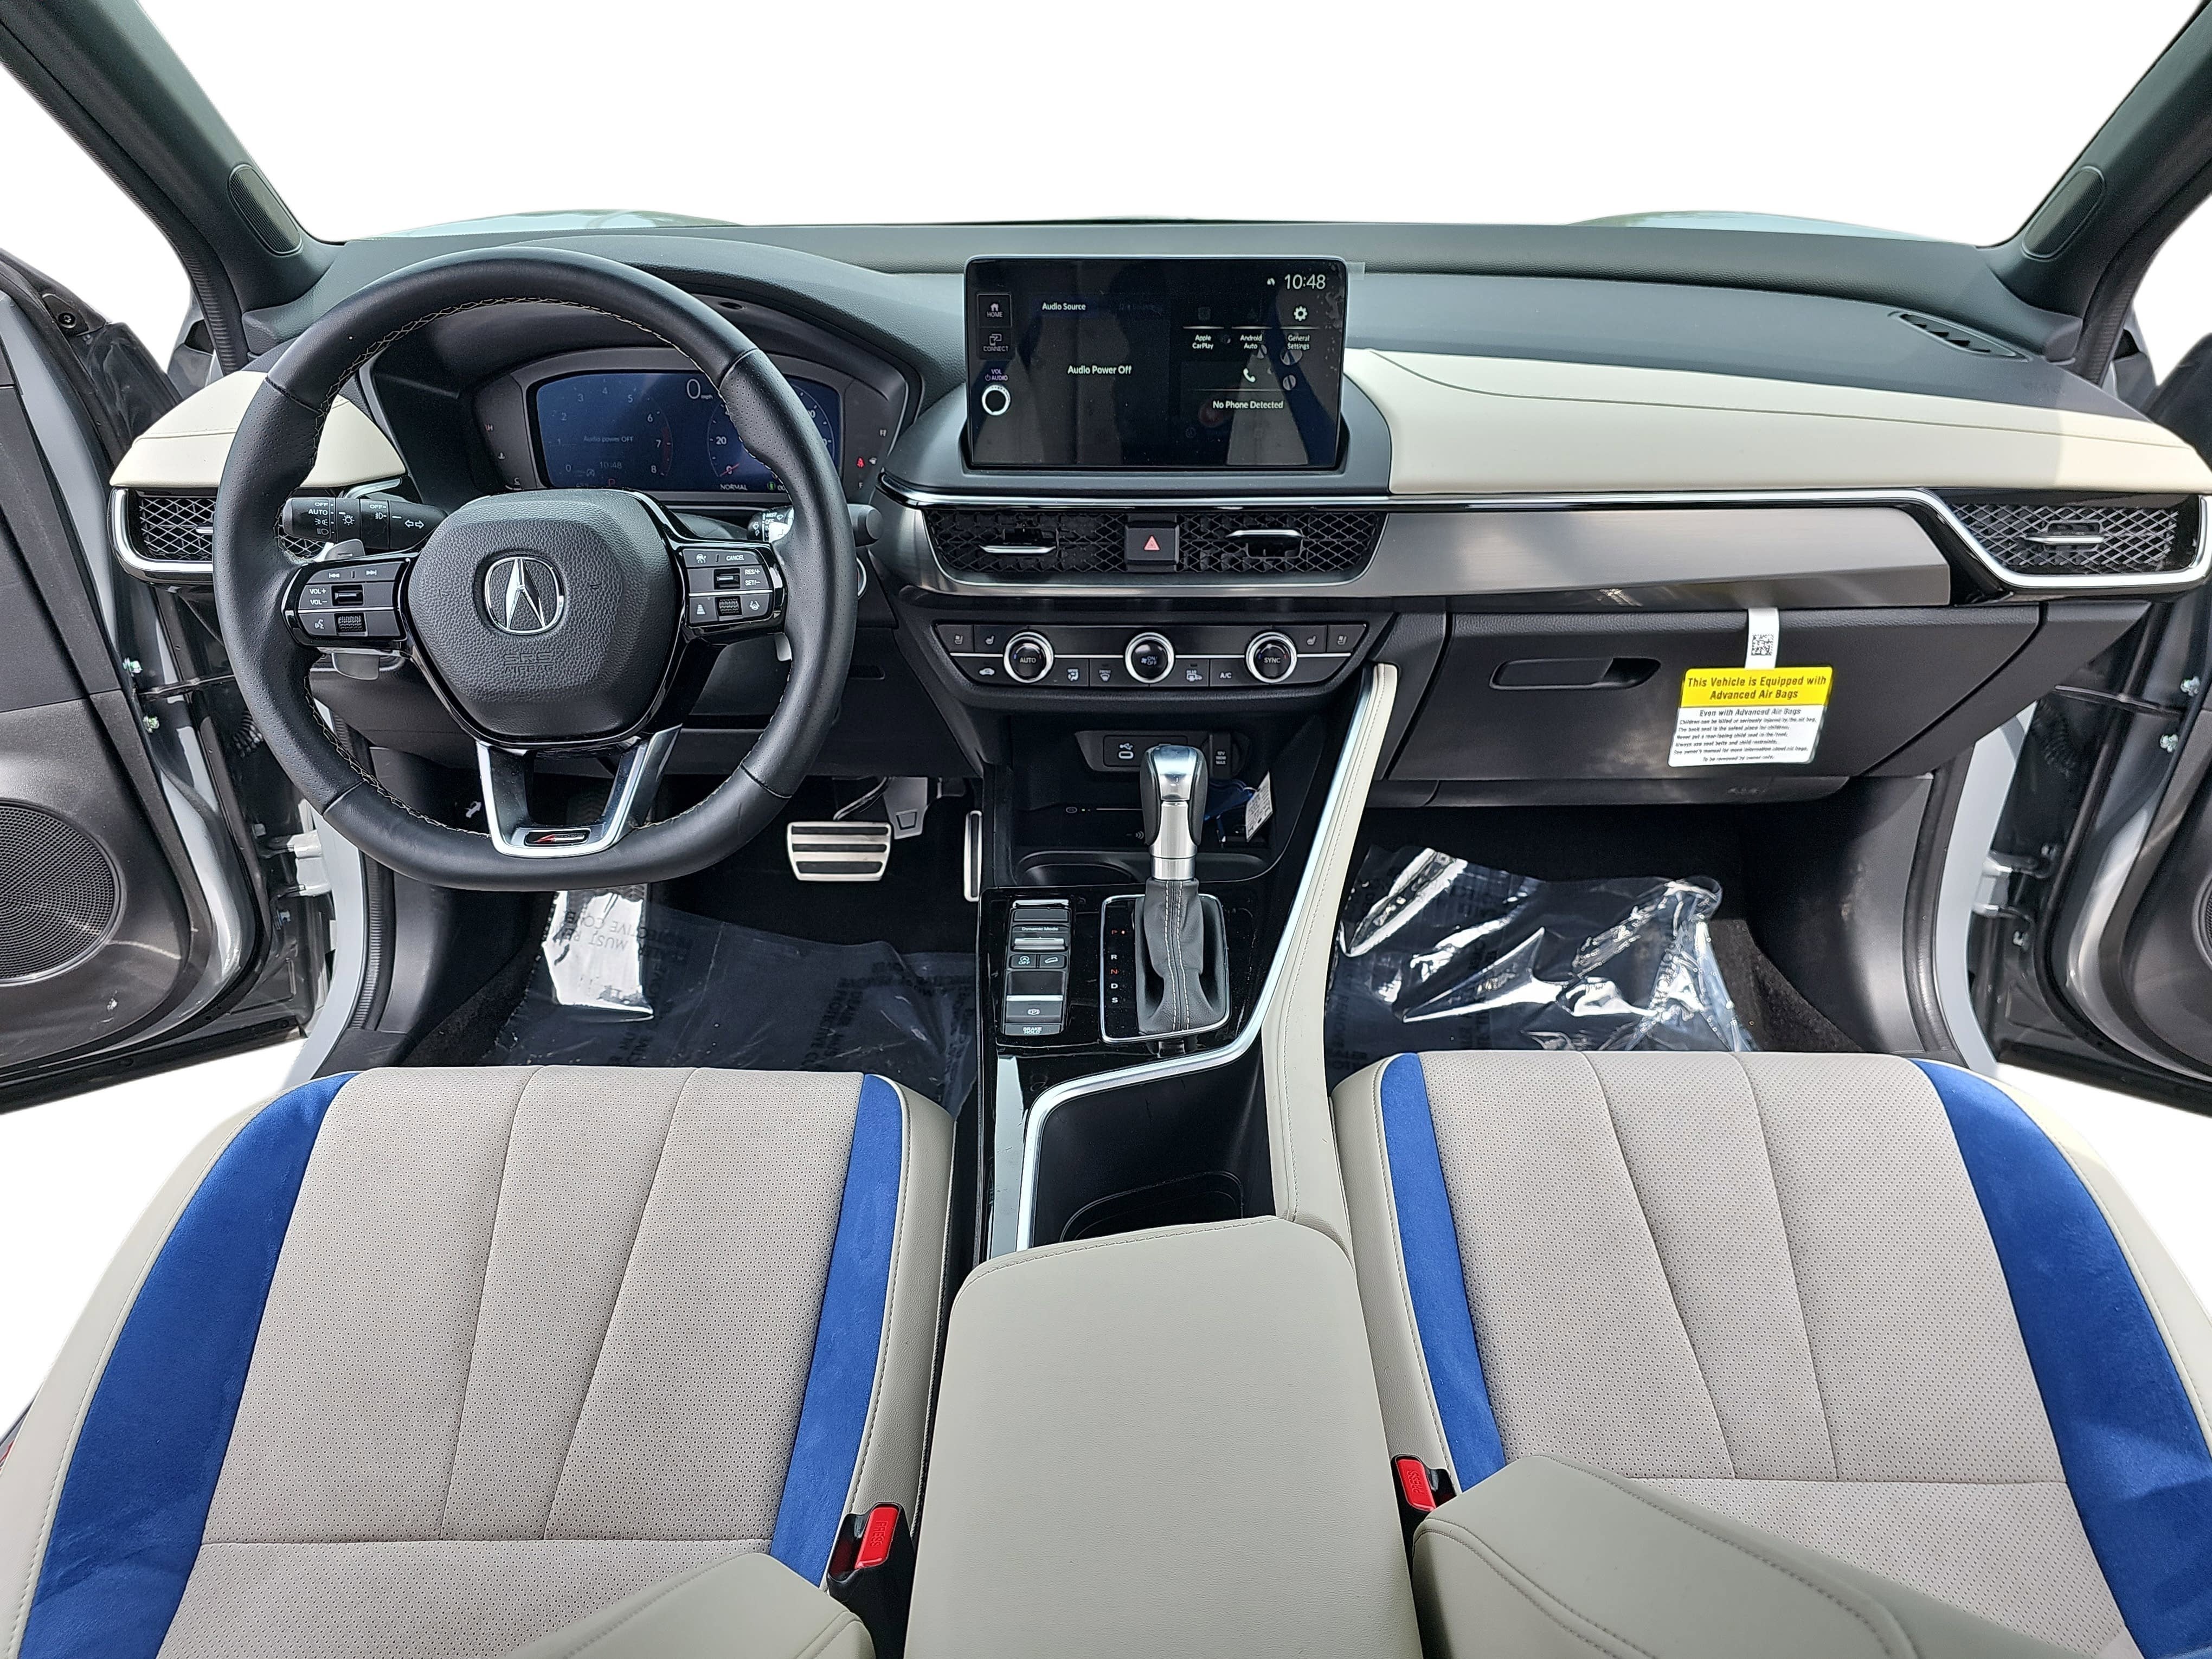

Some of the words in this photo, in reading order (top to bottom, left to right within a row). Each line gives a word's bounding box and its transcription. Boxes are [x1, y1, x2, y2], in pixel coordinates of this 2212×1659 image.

[1284, 273, 1326, 290] 10:48
[1063, 303, 1086, 311] Source
[1192, 342, 1214, 350] CarPlay
[1287, 342, 1310, 351] Settings
[1067, 365, 1090, 374] Audio
[1092, 365, 1116, 374] Power
[1118, 365, 1132, 374] Off
[686, 378, 700, 400] 0
[577, 393, 584, 402] 3
[627, 394, 633, 403] 5
[1213, 400, 1224, 409] No
[1225, 400, 1249, 409] Phone
[1250, 400, 1284, 409] Detected
[561, 412, 567, 421] 2
[647, 414, 653, 422] 6
[655, 439, 661, 448] 7
[716, 436, 727, 445] 20
[565, 464, 571, 472] 0
[599, 461, 622, 469] 10:48
[651, 465, 657, 473] 8
[503, 652, 552, 663] SRS
[1688, 677, 1707, 687] This
[1711, 677, 1745, 687] Vehicle
[1748, 676, 1757, 686] is
[1760, 676, 1803, 687] Equipped
[1806, 675, 1827, 685] with
[1709, 690, 1757, 700] Advanced
[1758, 690, 1773, 699] Air
[1775, 689, 1798, 700] Bags
[588, 930, 629, 950] MUST
[1406, 1470, 1425, 1495] PRESS
[870, 1520, 889, 1547] PRESS
